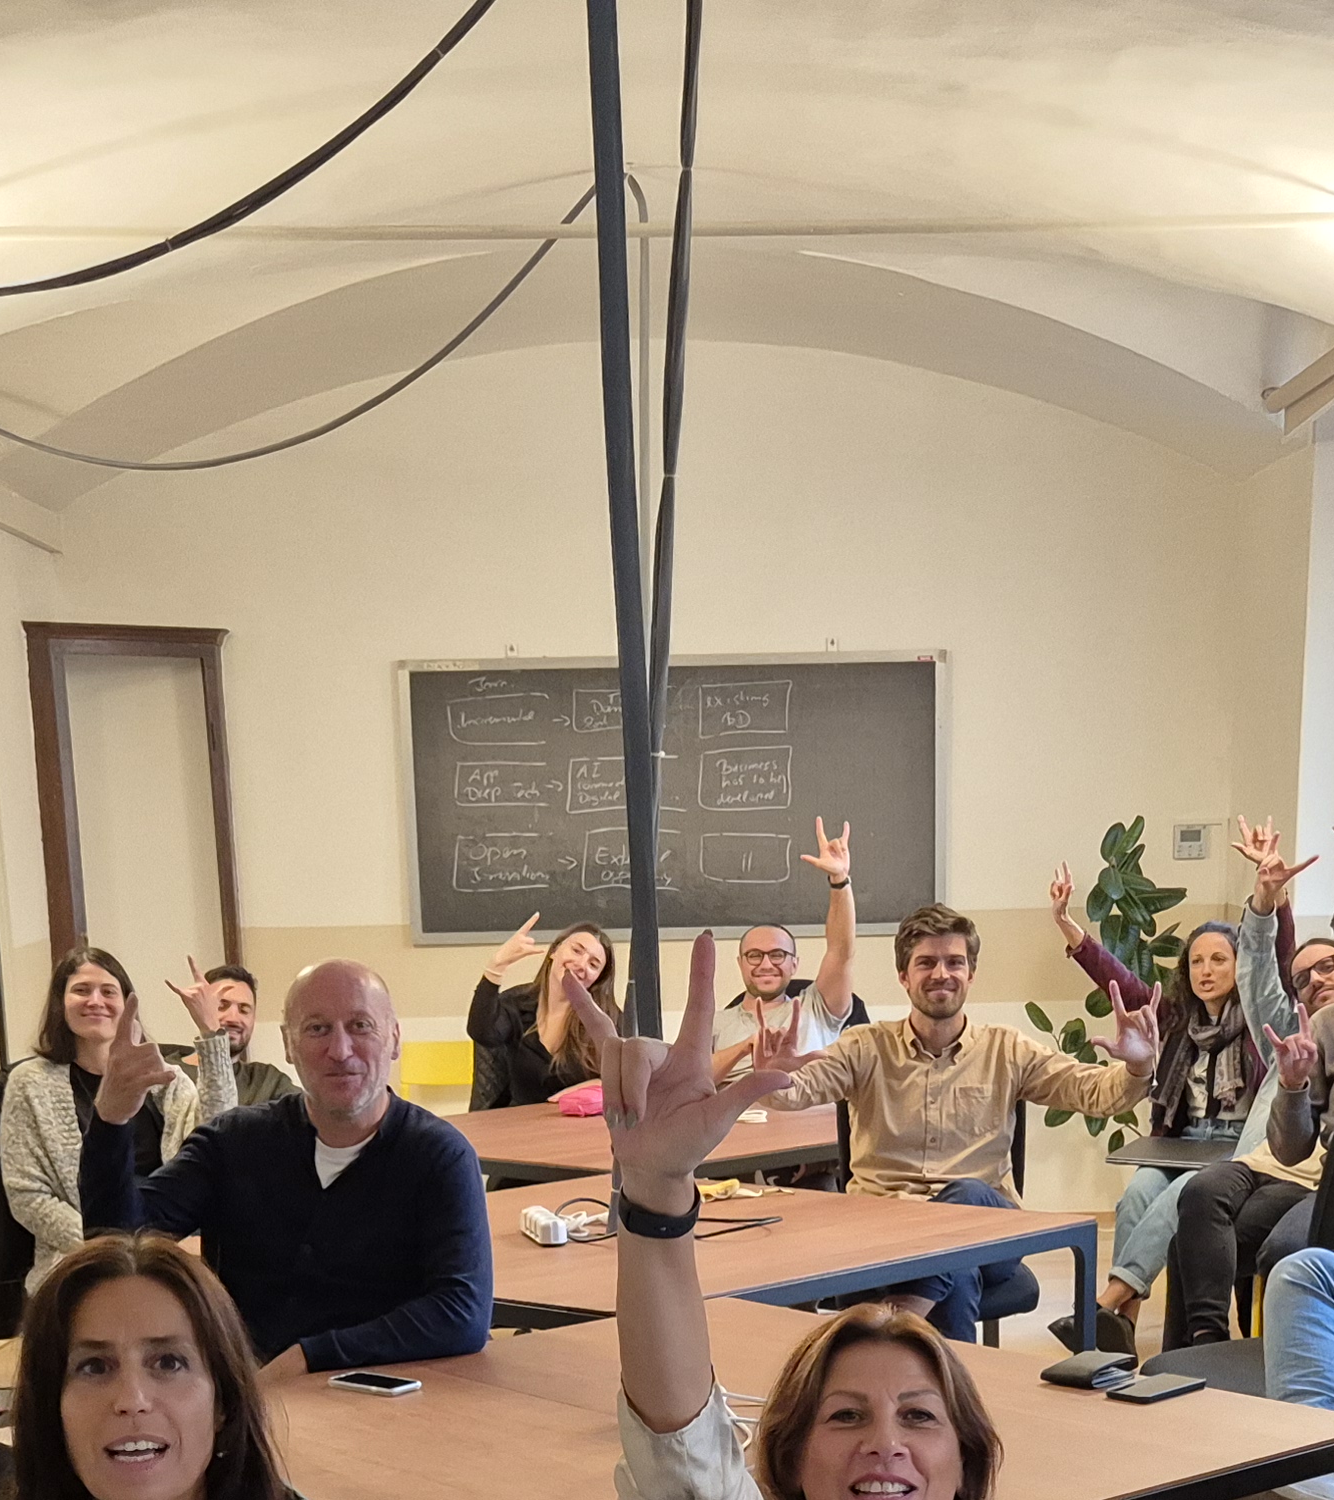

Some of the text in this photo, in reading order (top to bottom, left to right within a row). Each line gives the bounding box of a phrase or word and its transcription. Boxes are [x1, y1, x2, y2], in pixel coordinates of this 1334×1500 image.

[575, 762, 601, 778] AI
[716, 758, 778, 775] Business
[721, 774, 746, 789] has
[469, 843, 527, 866] Open
